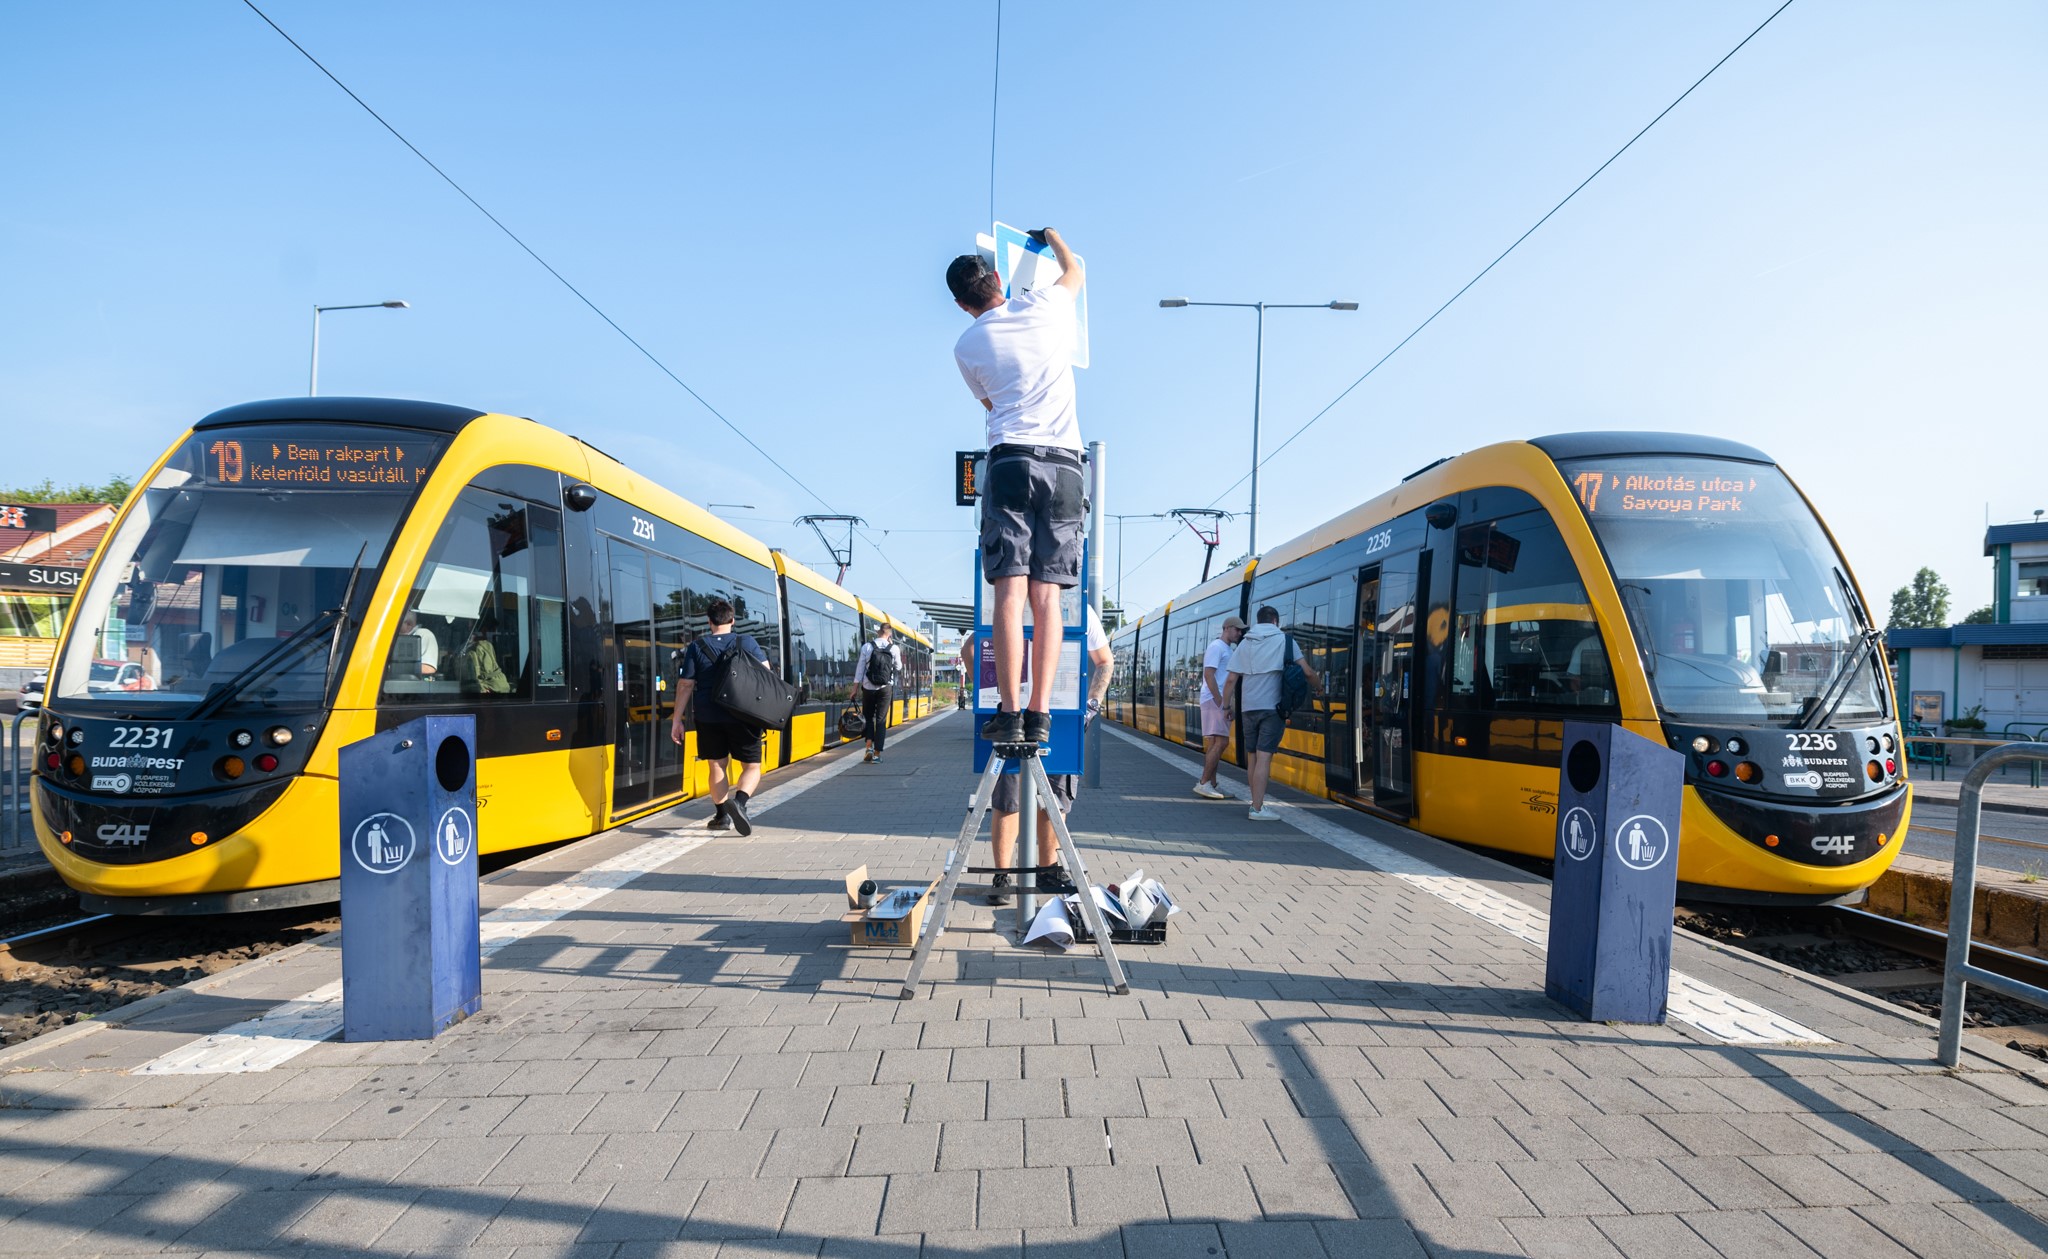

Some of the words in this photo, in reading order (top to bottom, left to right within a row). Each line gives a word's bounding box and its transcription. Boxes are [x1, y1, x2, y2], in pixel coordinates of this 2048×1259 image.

[210, 440, 243, 482] 19
[288, 444, 320, 461] Bem
[326, 445, 390, 463] rakpart
[251, 463, 331, 482] Kelenföld
[337, 465, 409, 483] vasútáll.
[1574, 473, 1603, 512] 17
[1625, 475, 1696, 491] Alkotás
[1701, 477, 1744, 492] utca
[1622, 495, 1693, 512] Savoya
[1698, 496, 1742, 511] Park
[632, 516, 655, 541] 2231
[1366, 528, 1392, 555] 2236
[109, 727, 174, 749] 2231
[1785, 733, 1838, 751] 2236
[1803, 758, 1848, 766] BUDAPEST
[96, 824, 150, 846] CAF
[1810, 835, 1855, 855] CAF
